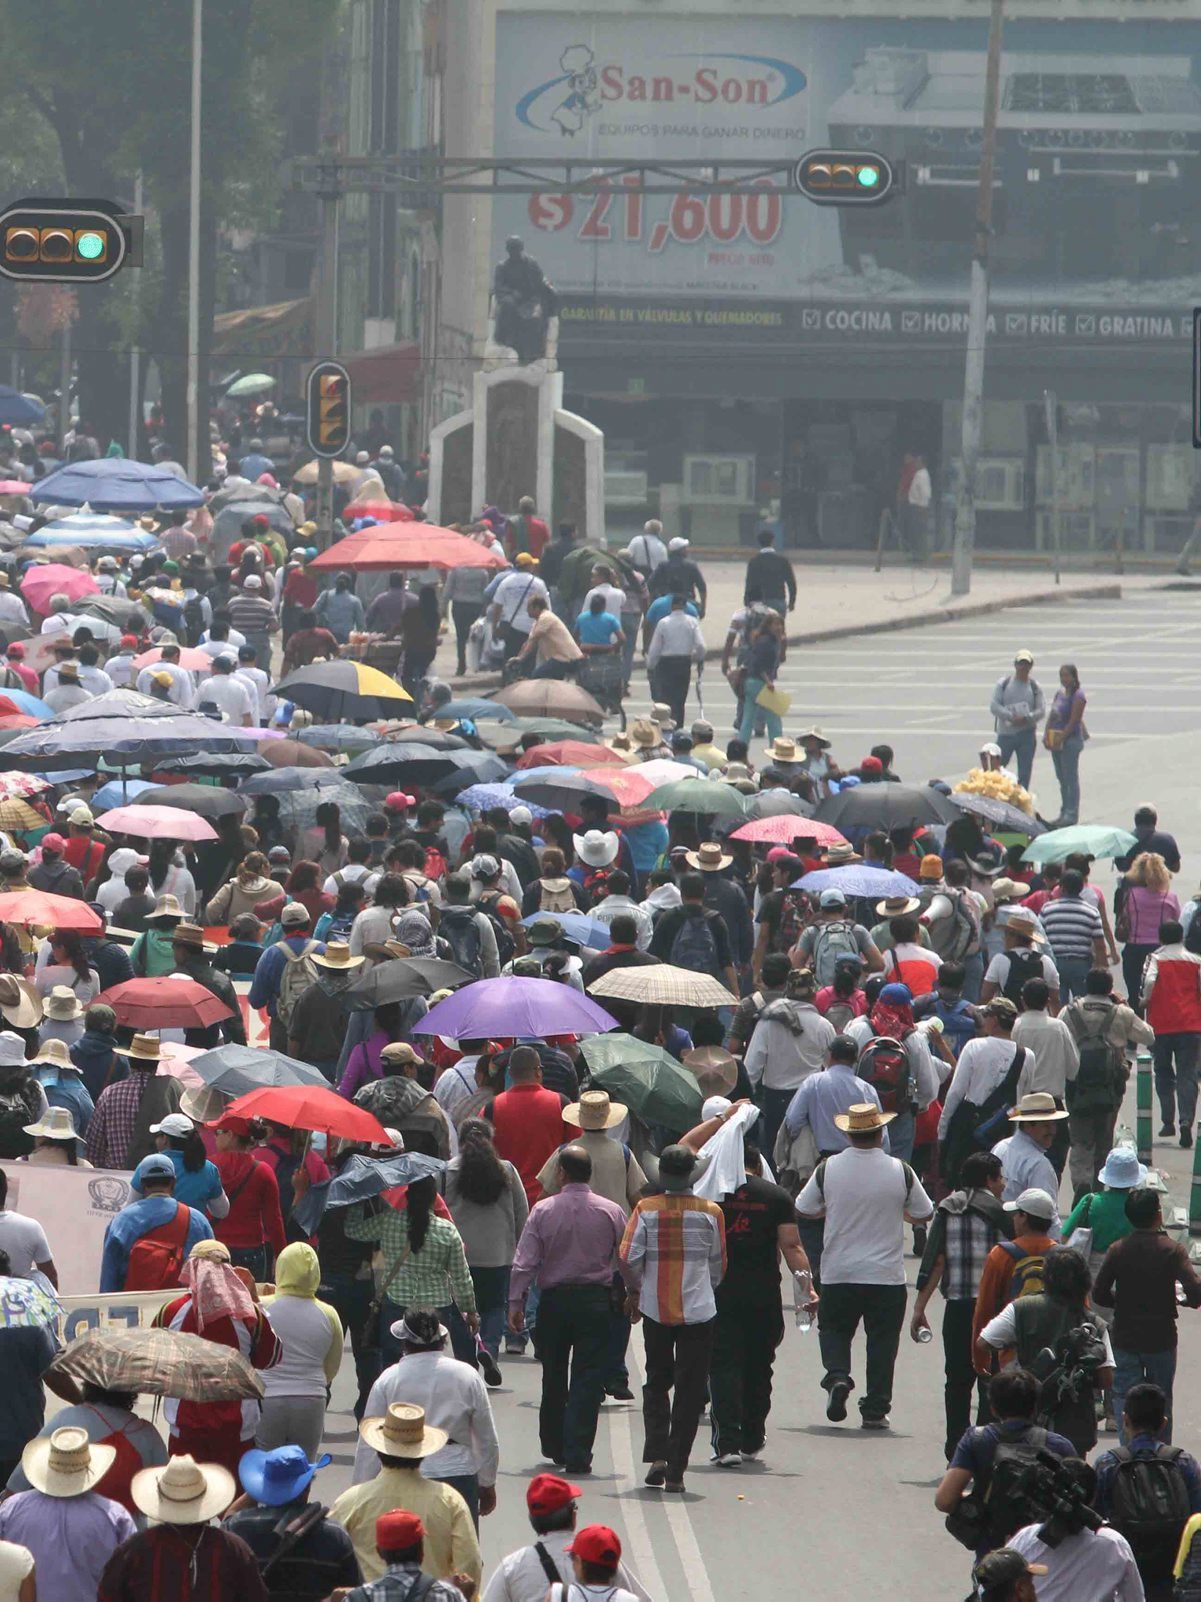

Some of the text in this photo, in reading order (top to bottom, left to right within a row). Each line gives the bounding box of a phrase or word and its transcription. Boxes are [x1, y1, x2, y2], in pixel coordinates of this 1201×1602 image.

[600, 65, 768, 105] San-Son
[701, 125, 749, 139] GANAR
[752, 127, 806, 141] DINERO
[825, 309, 892, 332] COCINA
[1030, 309, 1067, 335] FRÍE
[1098, 315, 1174, 337] GRATINA
